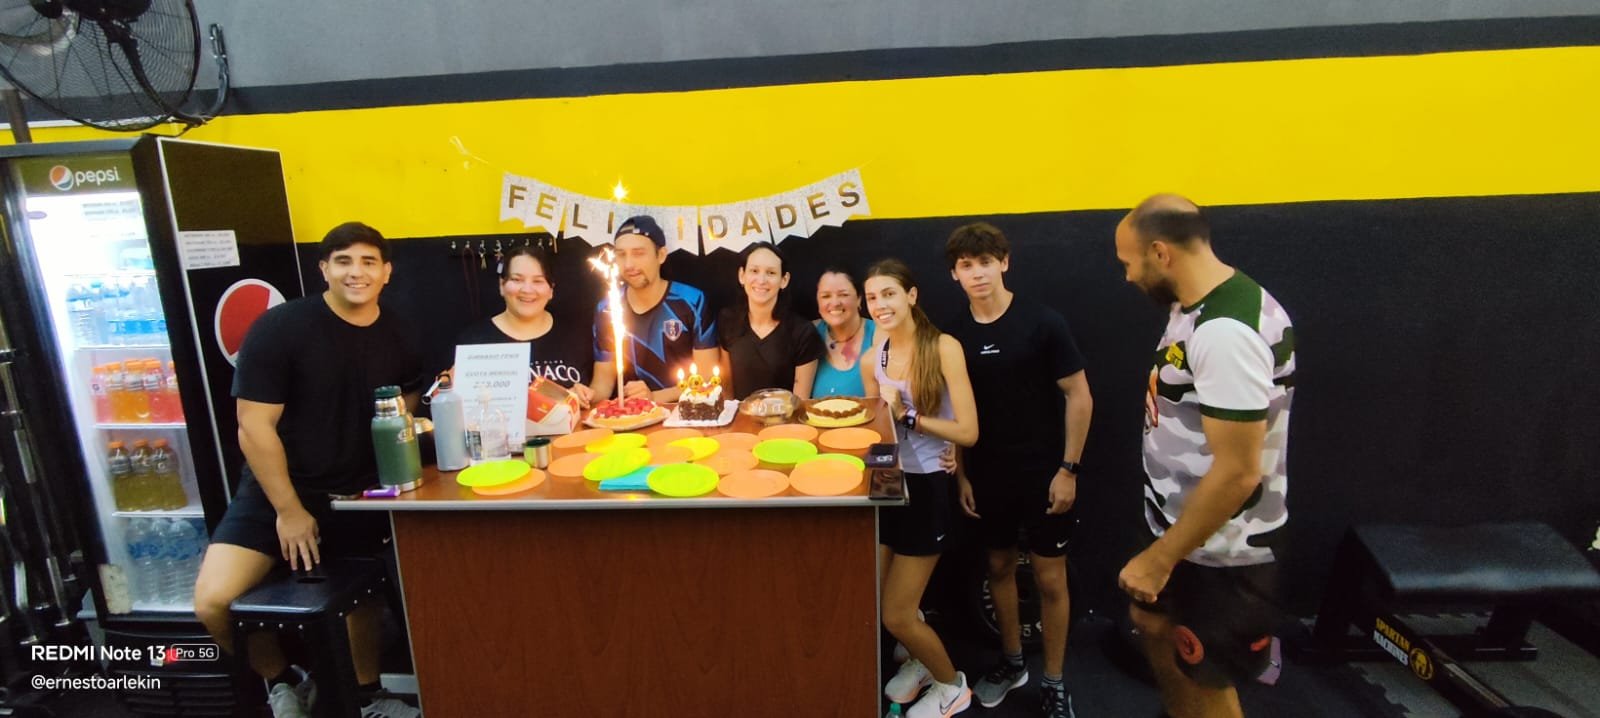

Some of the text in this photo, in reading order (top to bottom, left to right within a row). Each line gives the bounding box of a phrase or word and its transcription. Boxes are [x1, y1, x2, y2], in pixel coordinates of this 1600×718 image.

[75, 167, 120, 187] pepsi
[508, 182, 861, 241] FELIIDADES
[529, 364, 581, 383] NACO
[1373, 629, 1409, 666] MACHINES
[1376, 617, 1411, 651] SPARTAN
